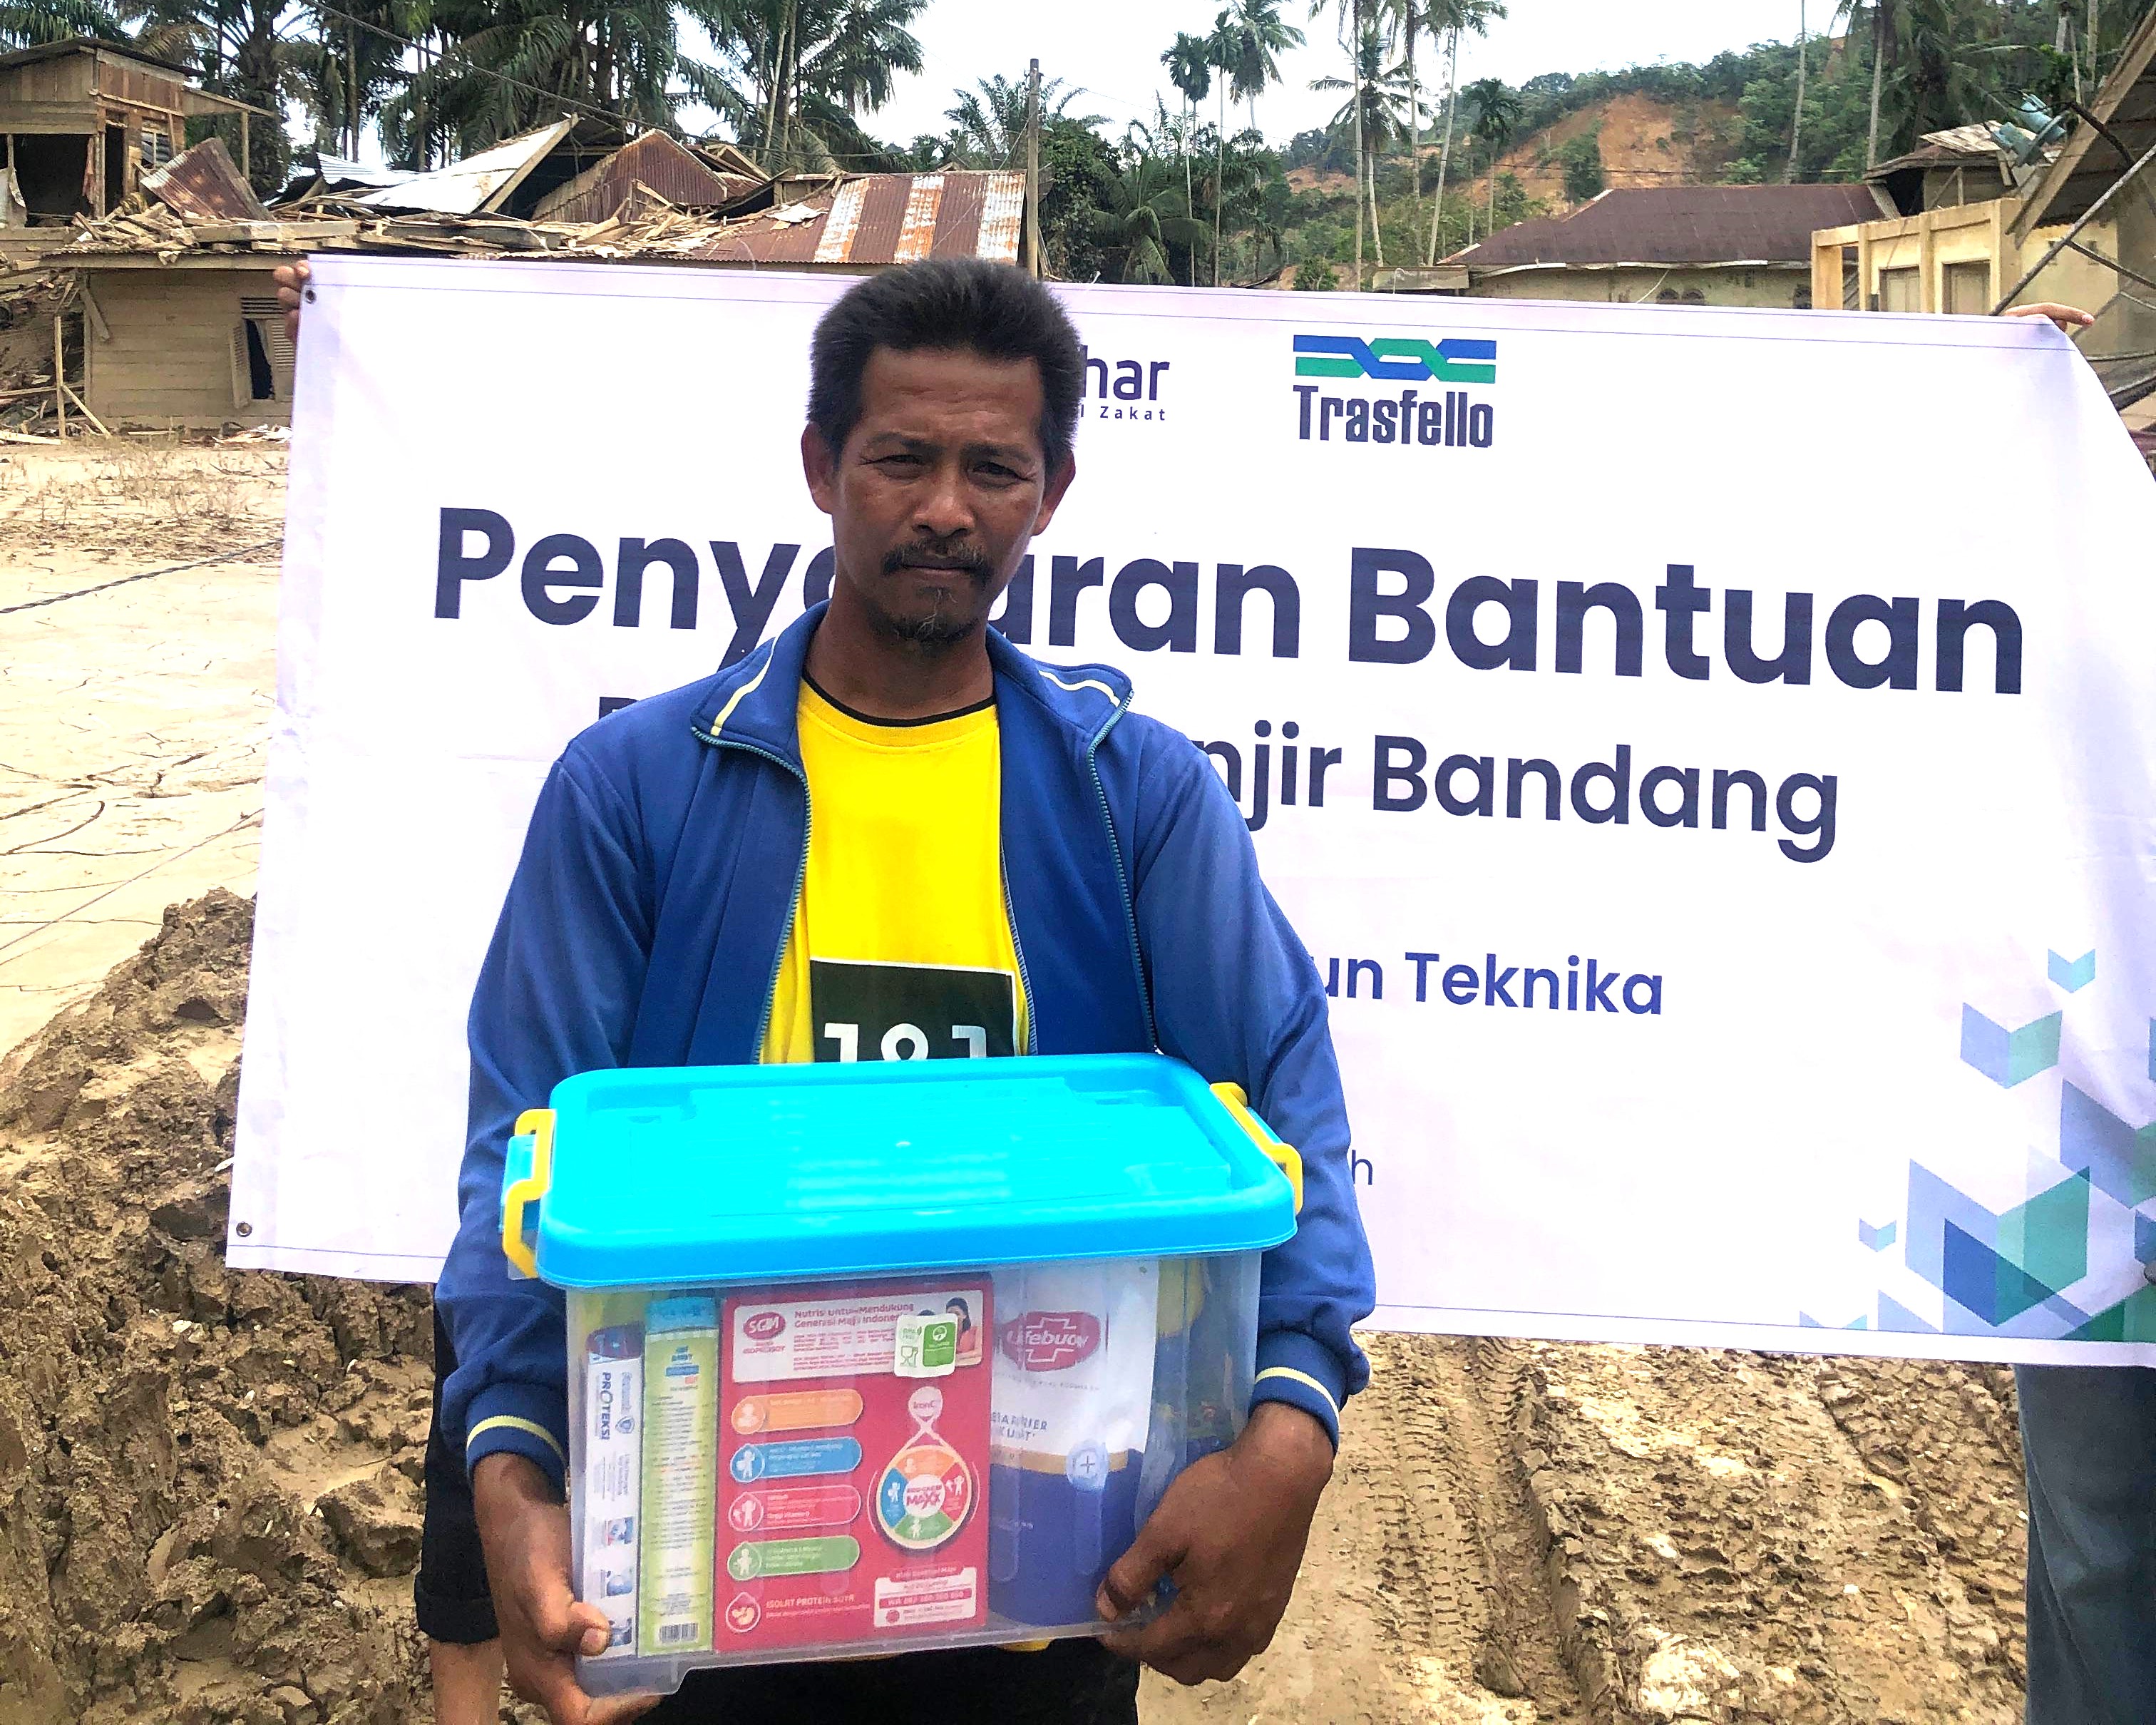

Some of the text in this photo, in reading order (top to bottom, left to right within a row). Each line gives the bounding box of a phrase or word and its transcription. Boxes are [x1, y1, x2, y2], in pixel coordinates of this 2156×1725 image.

[1100, 406, 1165, 421] Zakat
[1293, 384, 1493, 448] Trasfello
[1348, 547, 2023, 695] Bantuan
[1373, 734, 1838, 864] Bandang
[1405, 952, 1663, 1015] Teknika
[600, 1371, 613, 1440] PROTEKSI
